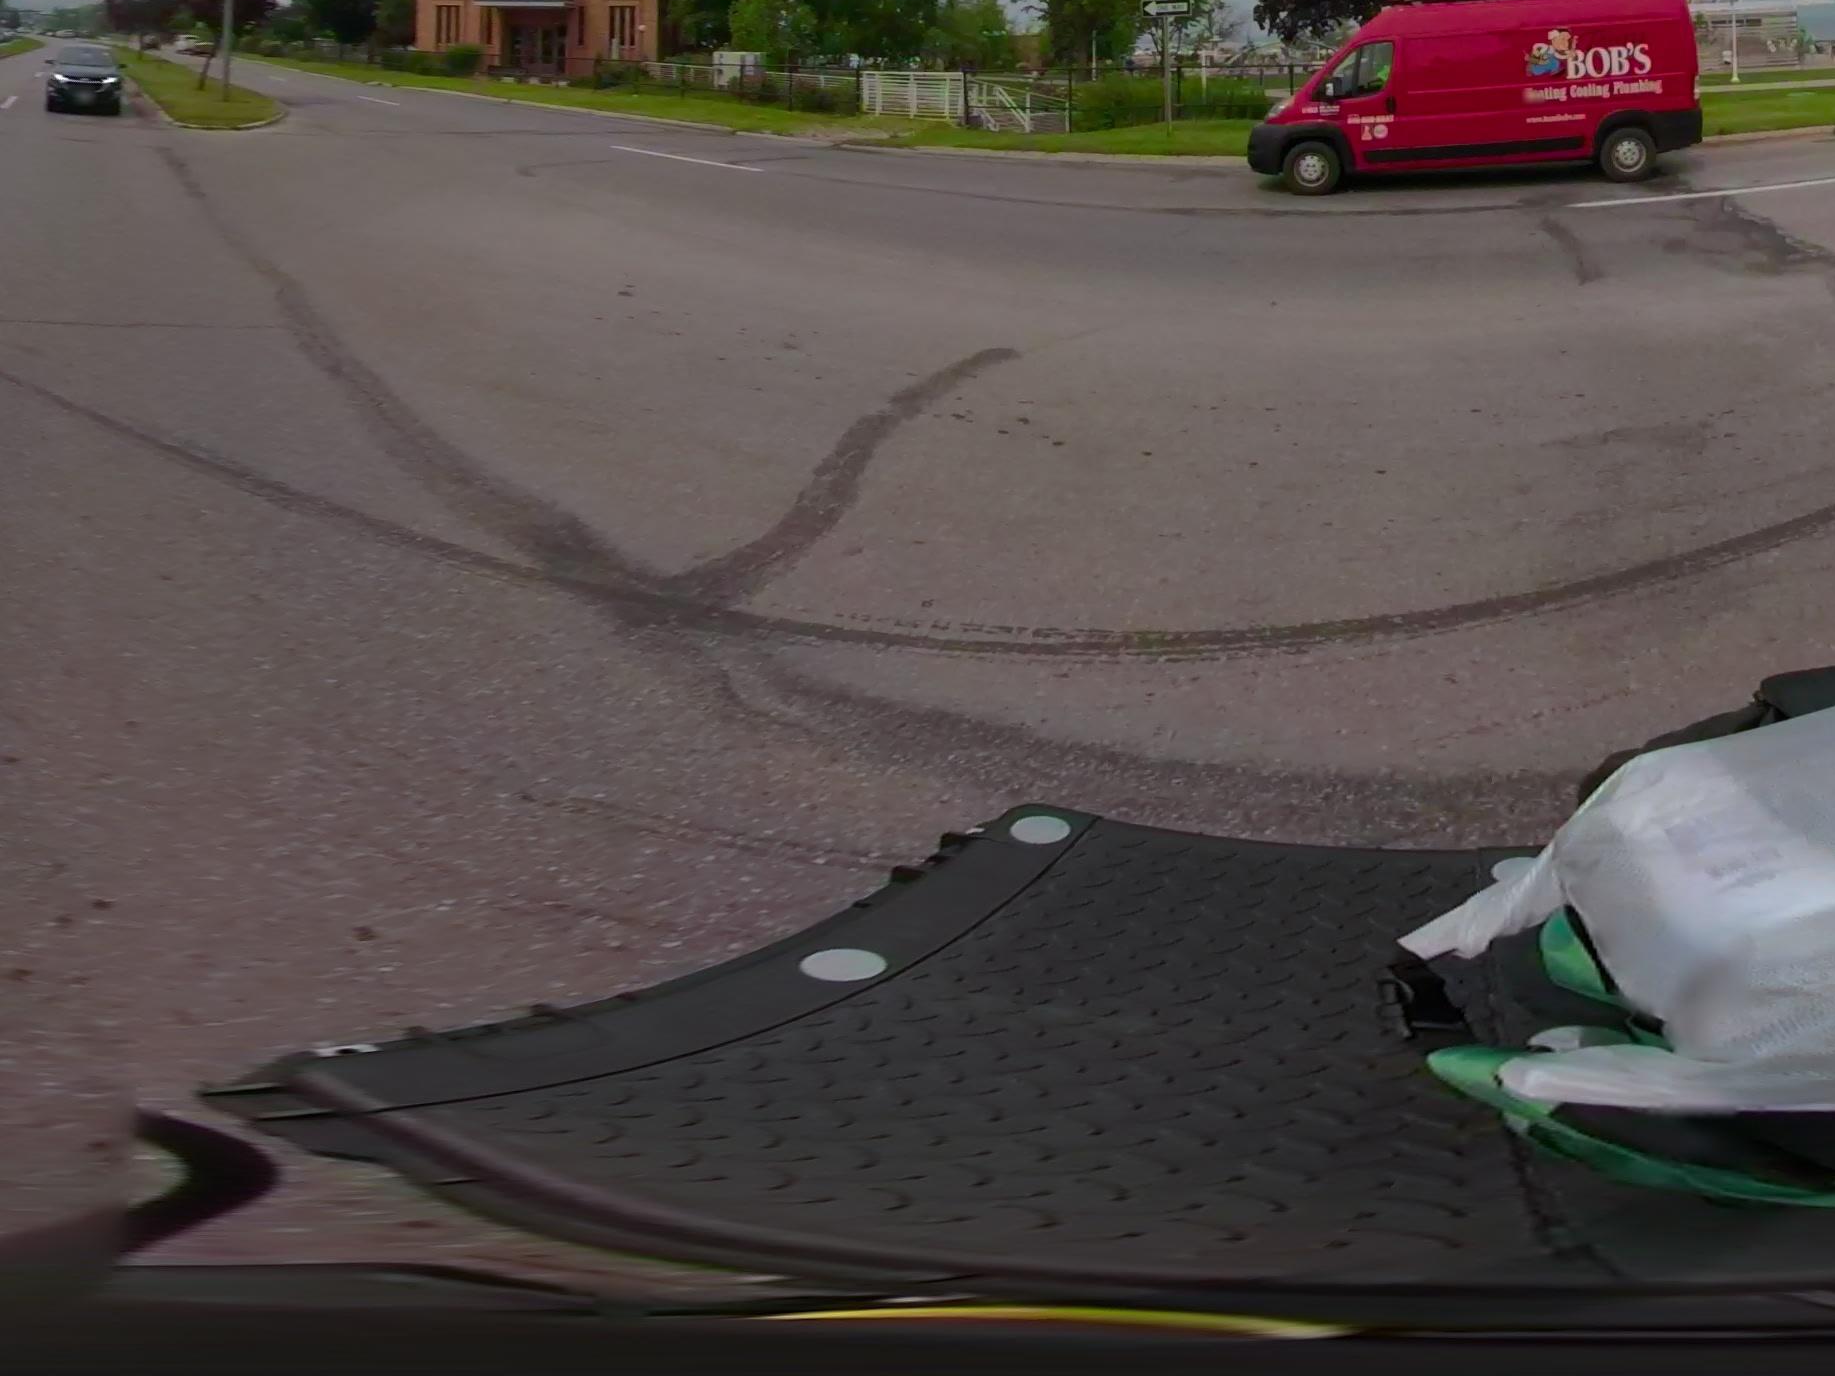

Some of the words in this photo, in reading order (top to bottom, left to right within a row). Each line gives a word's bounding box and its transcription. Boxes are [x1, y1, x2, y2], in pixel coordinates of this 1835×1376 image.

[1565, 42, 1652, 79] BOB'S
[1570, 84, 1611, 99] Cooling
[1613, 79, 1663, 95] Plumbing
